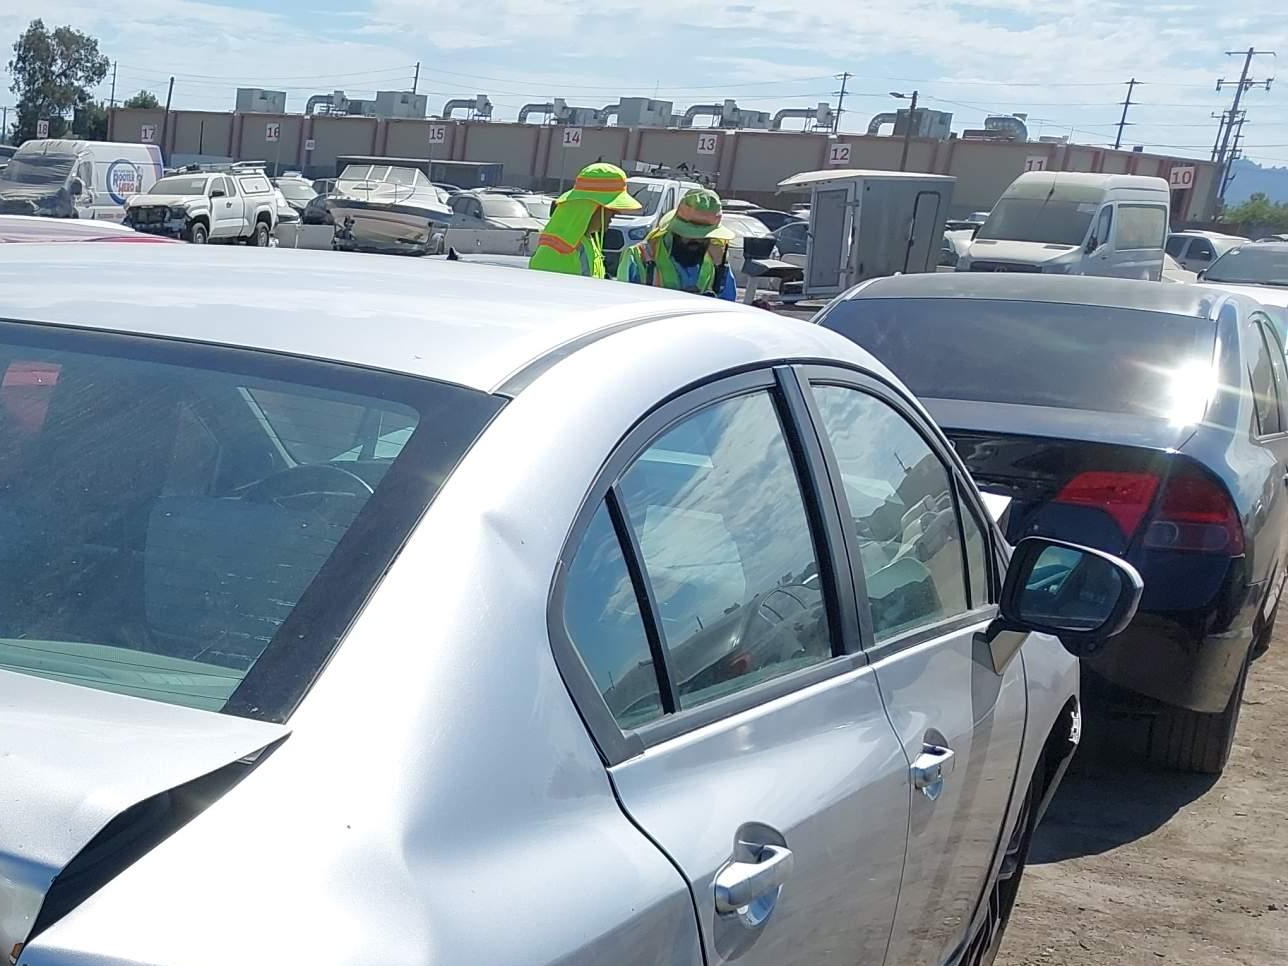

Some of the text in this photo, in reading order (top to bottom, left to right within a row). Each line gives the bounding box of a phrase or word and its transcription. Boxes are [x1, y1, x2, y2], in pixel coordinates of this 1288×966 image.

[38, 123, 48, 135] 18
[142, 128, 155, 140] 17
[431, 128, 444, 140] 15
[564, 131, 580, 144] 14
[698, 138, 716, 151] 13
[830, 147, 850, 161] 12
[1027, 159, 1044, 171] 11
[1171, 170, 1192, 185] 10
